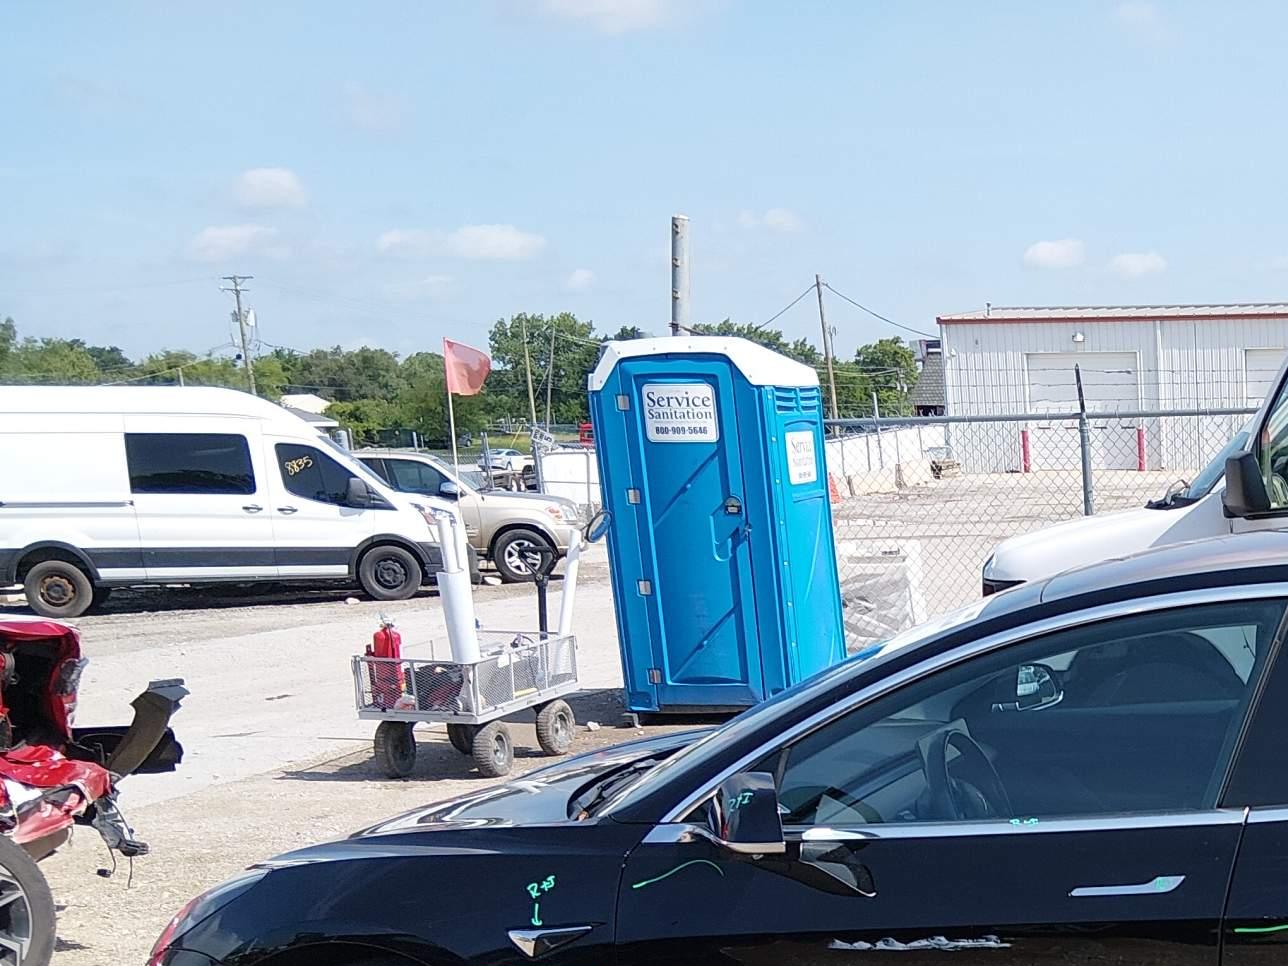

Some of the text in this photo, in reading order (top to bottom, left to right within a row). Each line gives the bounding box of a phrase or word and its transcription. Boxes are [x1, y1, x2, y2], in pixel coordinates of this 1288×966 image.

[646, 391, 711, 408] Service
[647, 408, 713, 420] Sanitation
[655, 426, 708, 435] 800-909-5646
